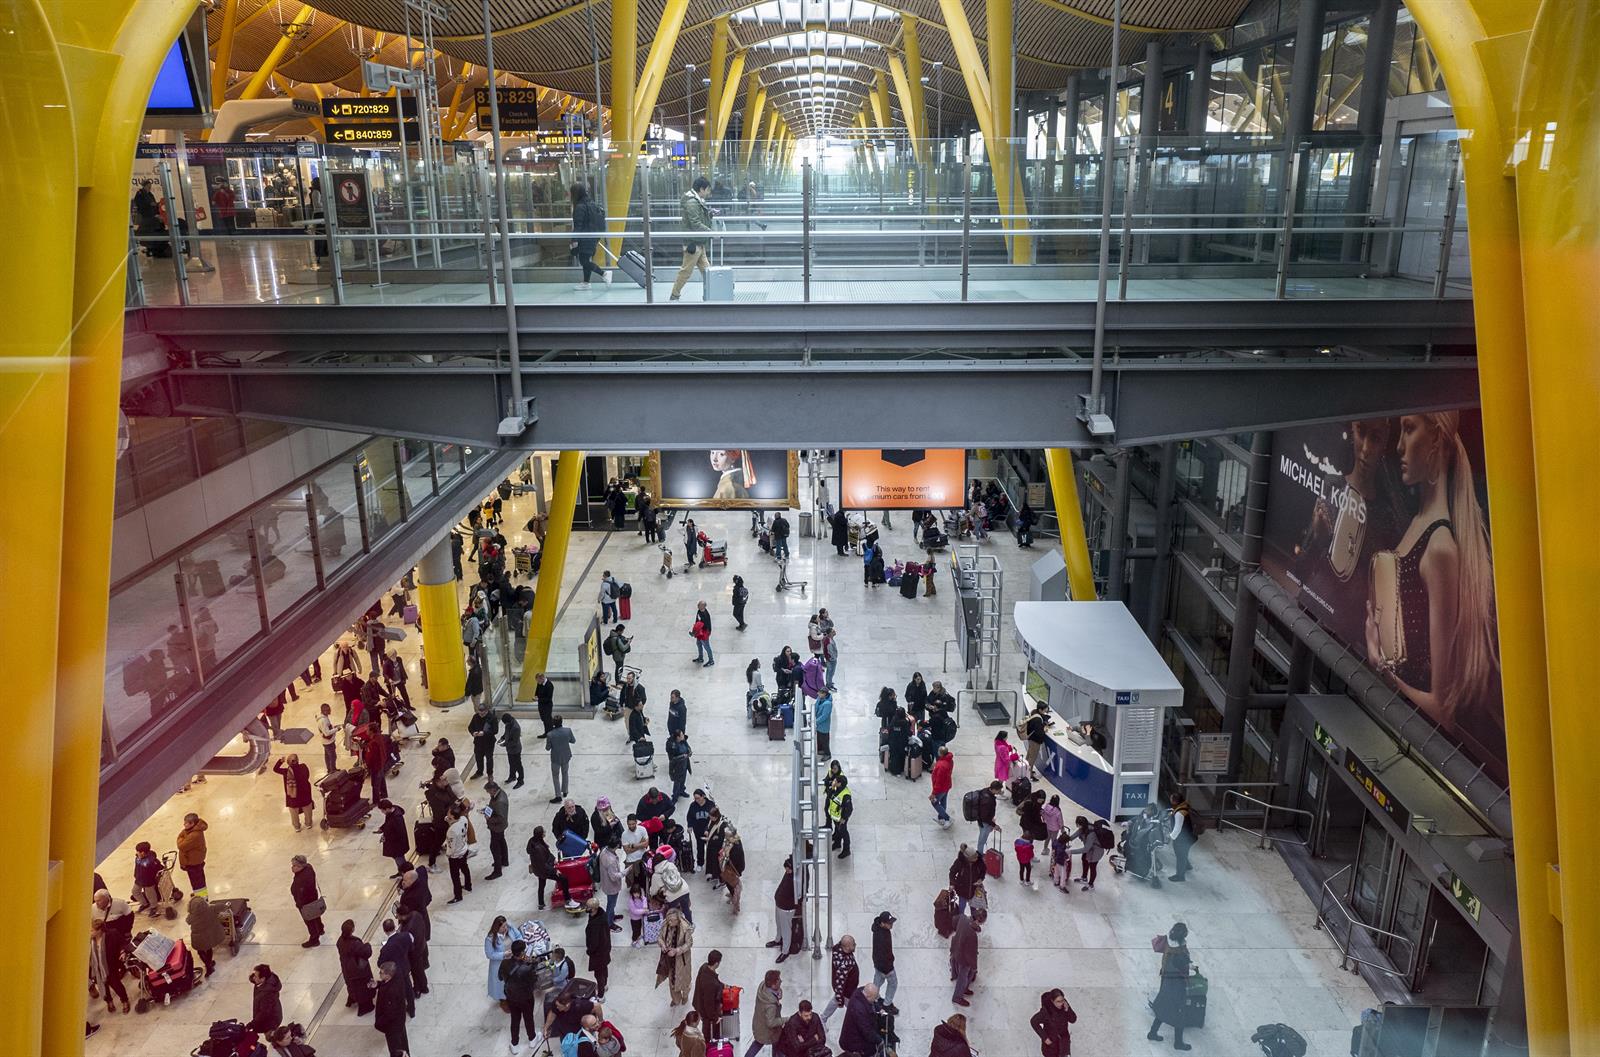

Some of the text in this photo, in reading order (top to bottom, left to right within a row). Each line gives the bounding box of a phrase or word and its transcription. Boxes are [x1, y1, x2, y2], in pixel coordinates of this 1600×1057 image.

[1165, 82, 1173, 115] 4
[1280, 455, 1366, 524] MICHAEL KORS
[1125, 792, 1147, 800] TAXI
